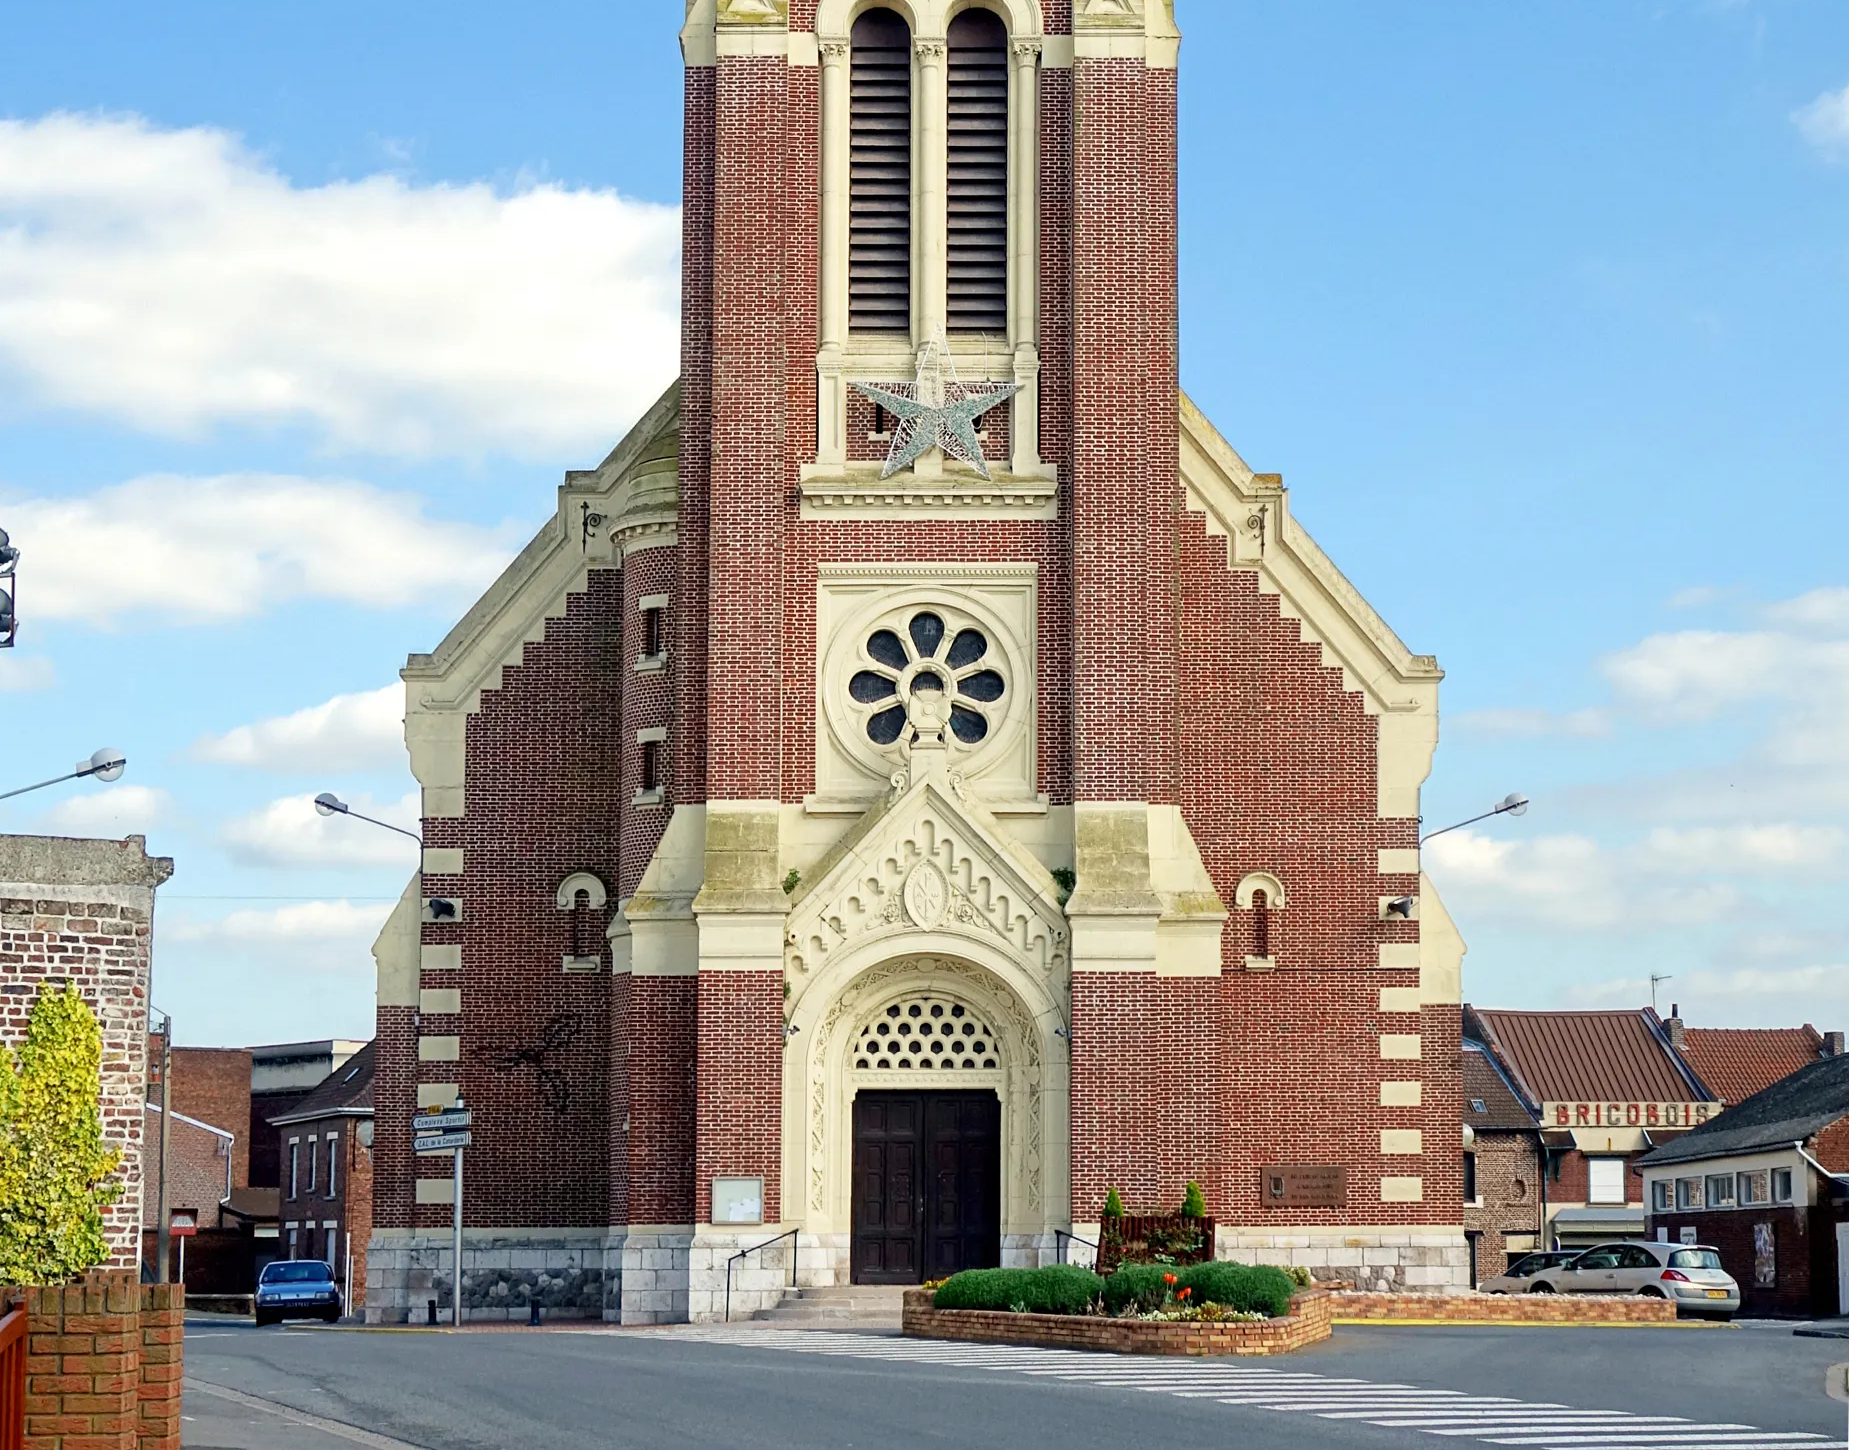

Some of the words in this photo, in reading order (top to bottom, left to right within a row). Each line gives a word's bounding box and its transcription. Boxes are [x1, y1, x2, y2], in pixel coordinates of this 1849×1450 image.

[417, 1118, 443, 1127] Complexe
[445, 1116, 465, 1125] Sportif
[1556, 1103, 1709, 1126] BRICOBOIS
